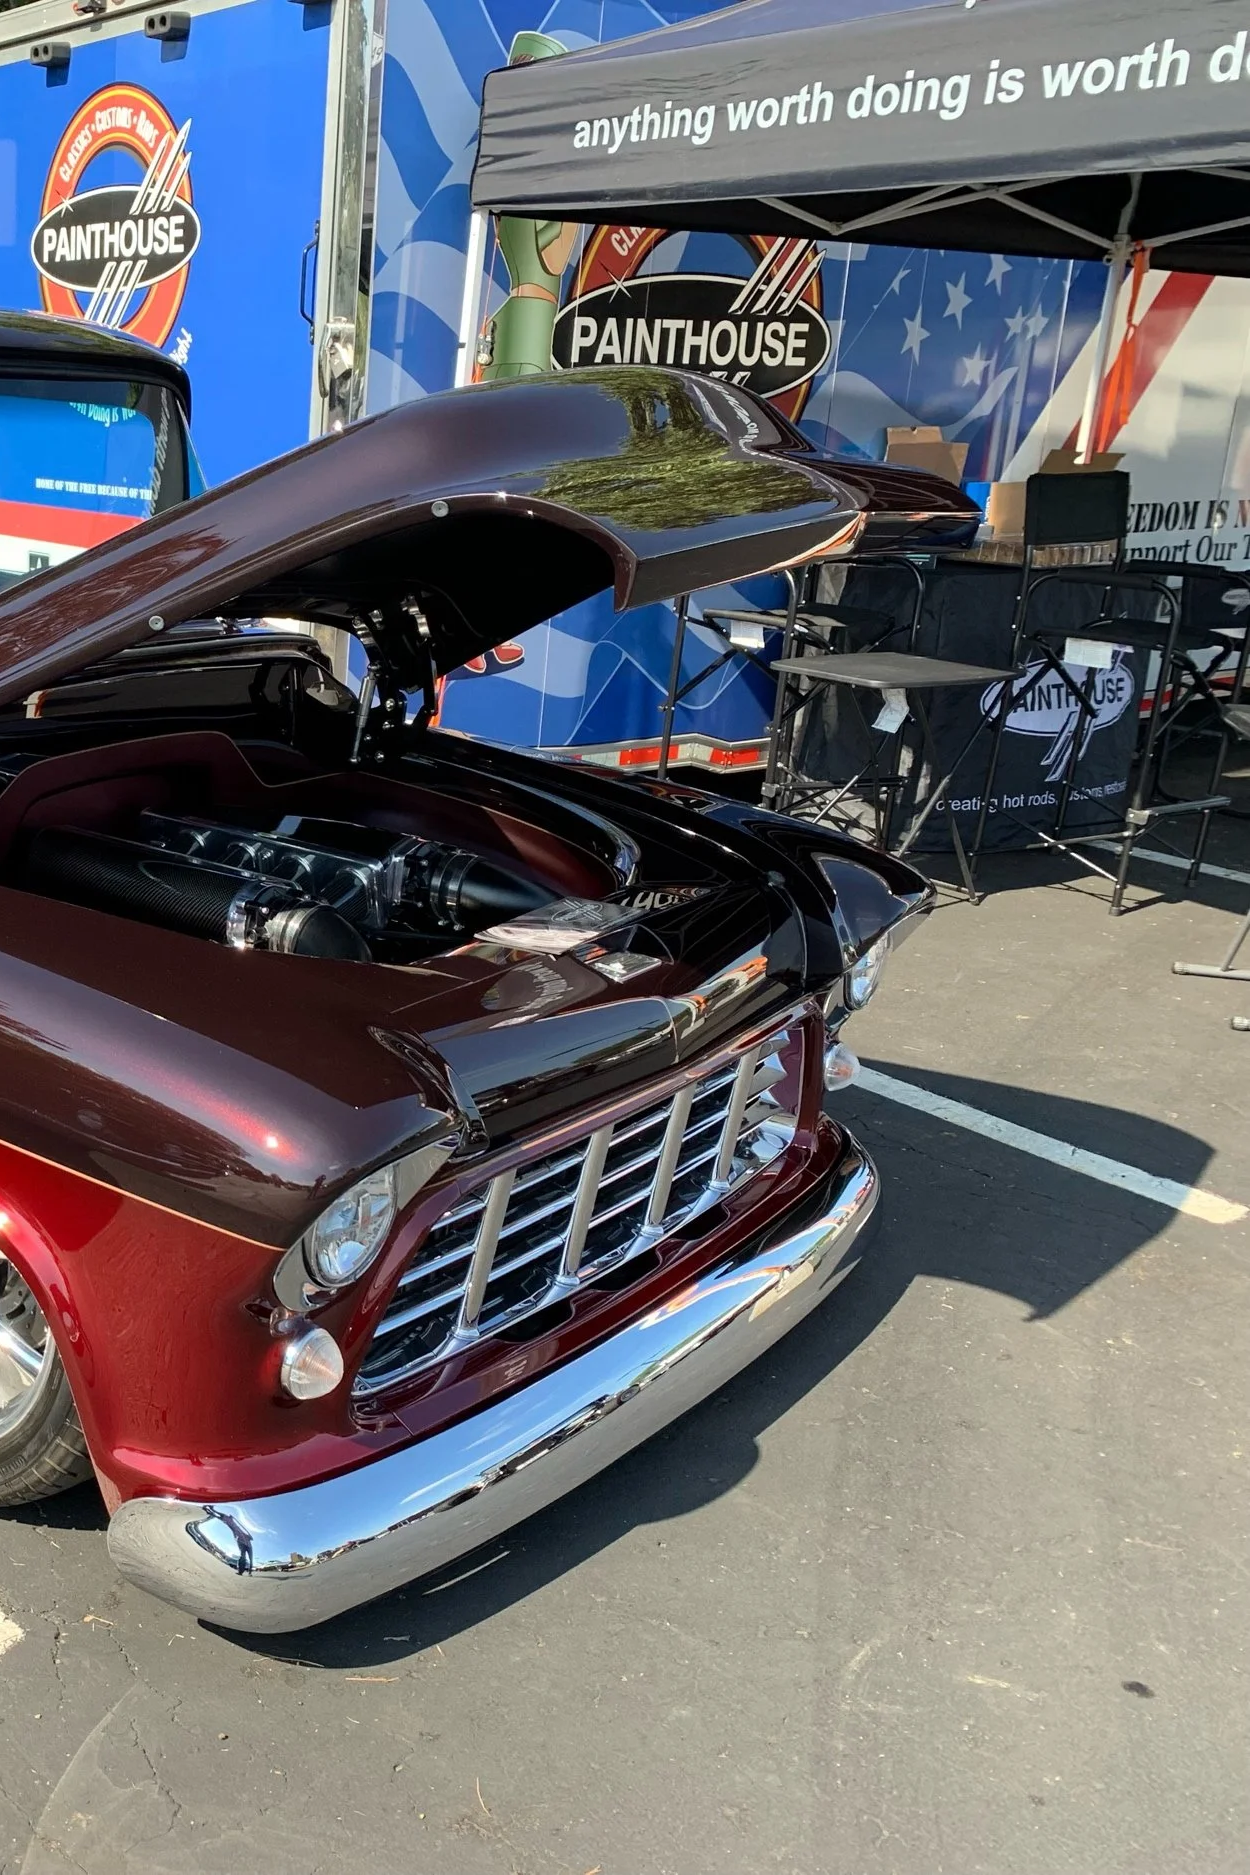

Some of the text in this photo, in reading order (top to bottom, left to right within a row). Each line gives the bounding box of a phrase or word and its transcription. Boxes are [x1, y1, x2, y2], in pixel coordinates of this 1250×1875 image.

[573, 101, 716, 154] anything
[726, 81, 834, 131] worth
[846, 70, 971, 120] doing
[983, 60, 1025, 104] is
[1041, 39, 1190, 99] worth
[42, 215, 185, 263] PAINTHOUSE
[570, 316, 810, 367] PAINTHOUSE
[54, 480, 64, 491] OF
[64, 481, 79, 493] THE
[79, 482, 96, 495] FREE
[97, 484, 128, 498] BECAUSE
[128, 487, 139, 499] OF
[1196, 535, 1238, 562] Our
[1002, 794, 1025, 810] hot
